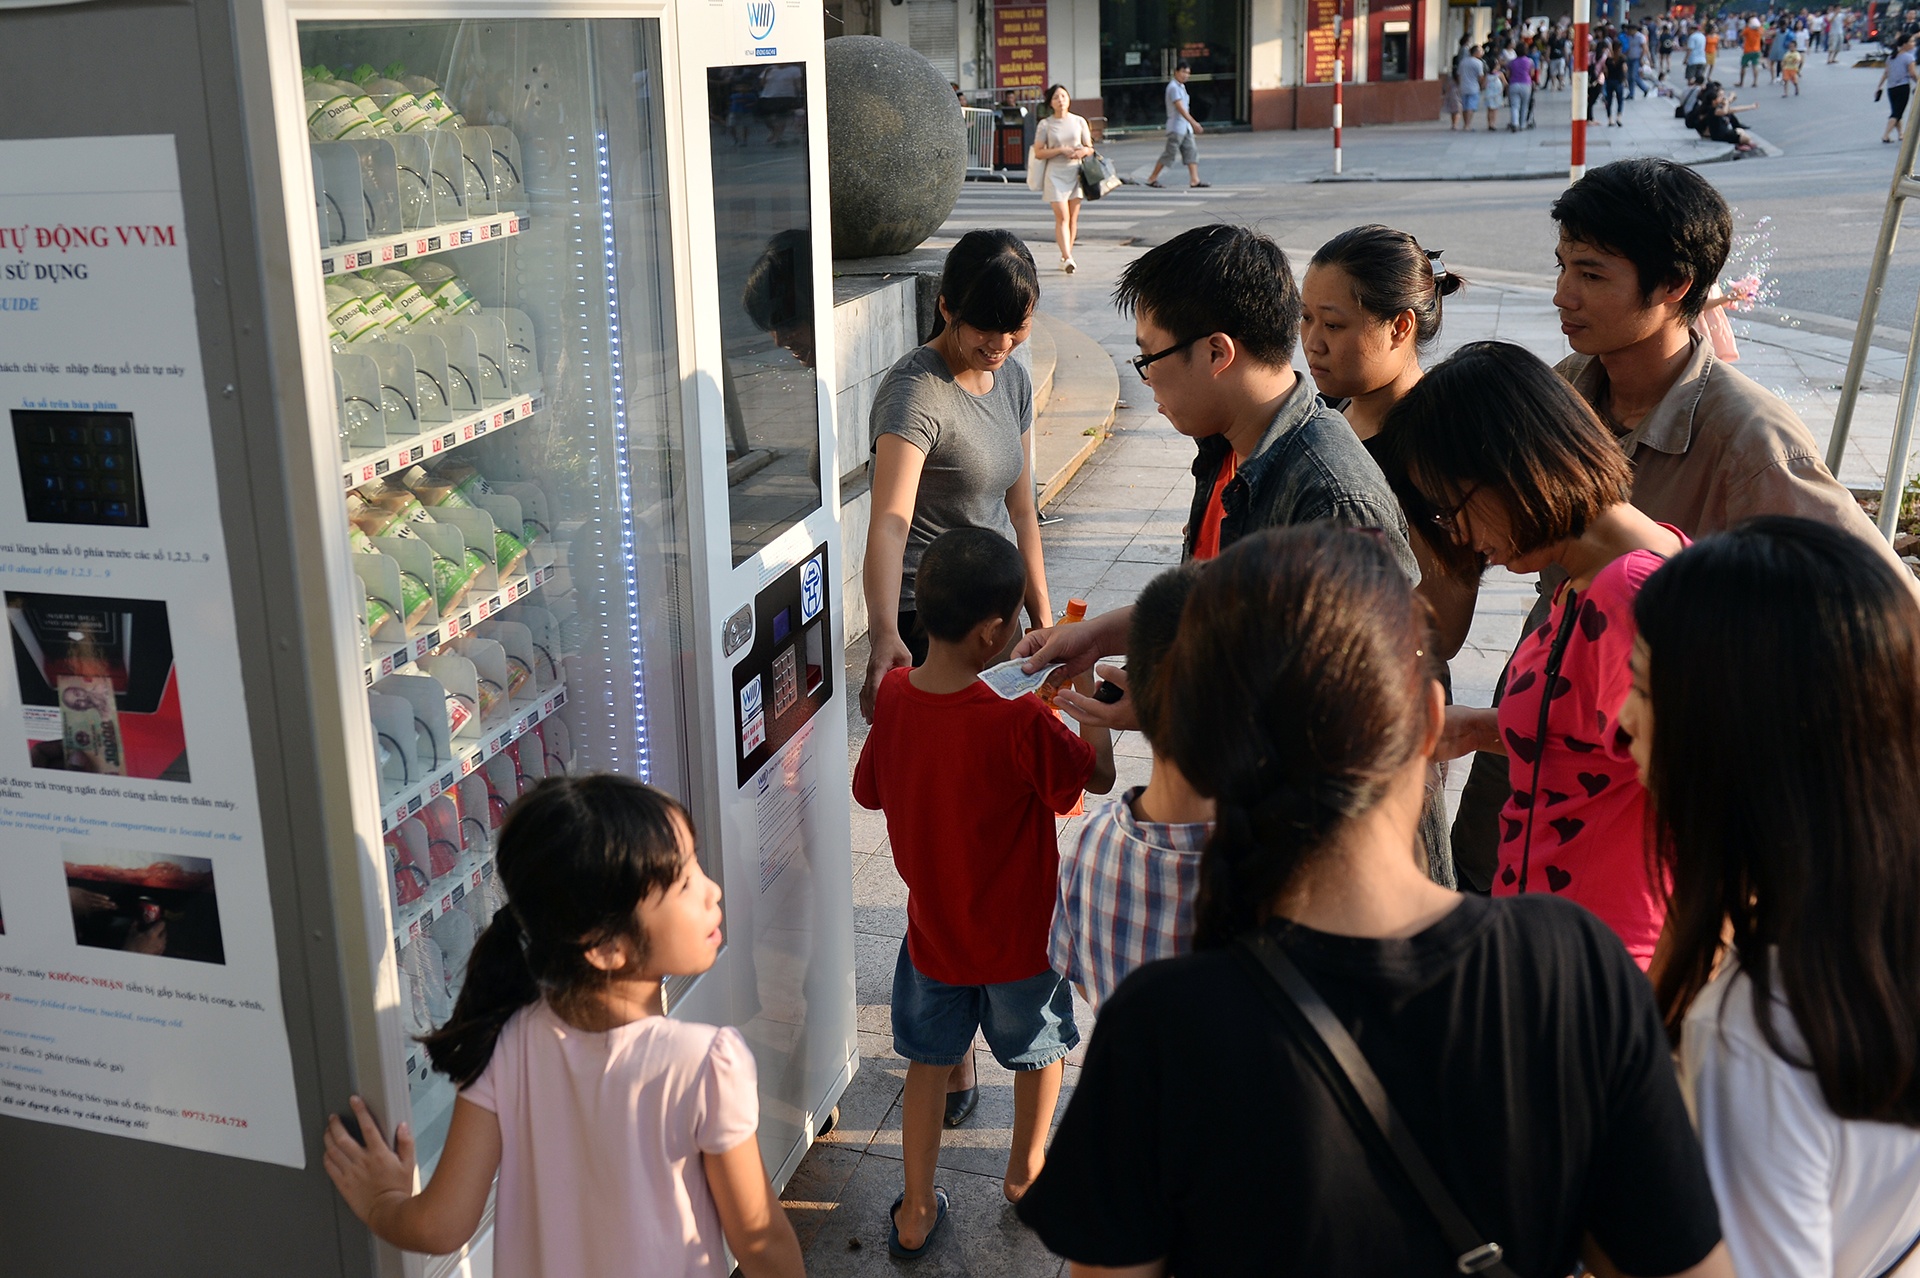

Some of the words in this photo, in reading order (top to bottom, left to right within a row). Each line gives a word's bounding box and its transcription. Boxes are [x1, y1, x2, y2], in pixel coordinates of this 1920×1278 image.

[1000, 62, 1022, 72] NGÂN
[1024, 61, 1045, 72] HÀNG
[1003, 75, 1020, 86] NHÀ
[1021, 75, 1043, 85] NƯỚC
[0, 225, 30, 253] TỰ
[35, 224, 109, 253] ĐỘNG
[115, 225, 177, 247] VVM
[417, 239, 426, 253] 07
[481, 226, 489, 239] 09
[510, 220, 518, 233] 10
[6, 260, 30, 280] SỬ
[35, 264, 89, 283] DỤNG
[0, 297, 39, 311] UIDE
[40, 363, 59, 375] việc
[66, 363, 89, 376] nhập
[50, 399, 69, 409] trên
[433, 437, 441, 452] 17
[74, 548, 80, 556] 0
[16, 565, 42, 574] ahead
[54, 567, 67, 576] the
[49, 783, 73, 794] trong
[15, 810, 50, 820] returned
[64, 815, 76, 823] the
[79, 816, 108, 827] bottom
[111, 820, 167, 834] compartment
[179, 826, 212, 838] located
[228, 831, 242, 841] the
[48, 971, 90, 985] KHÔNG
[91, 977, 124, 990] NHẬN
[40, 998, 65, 1010] folded
